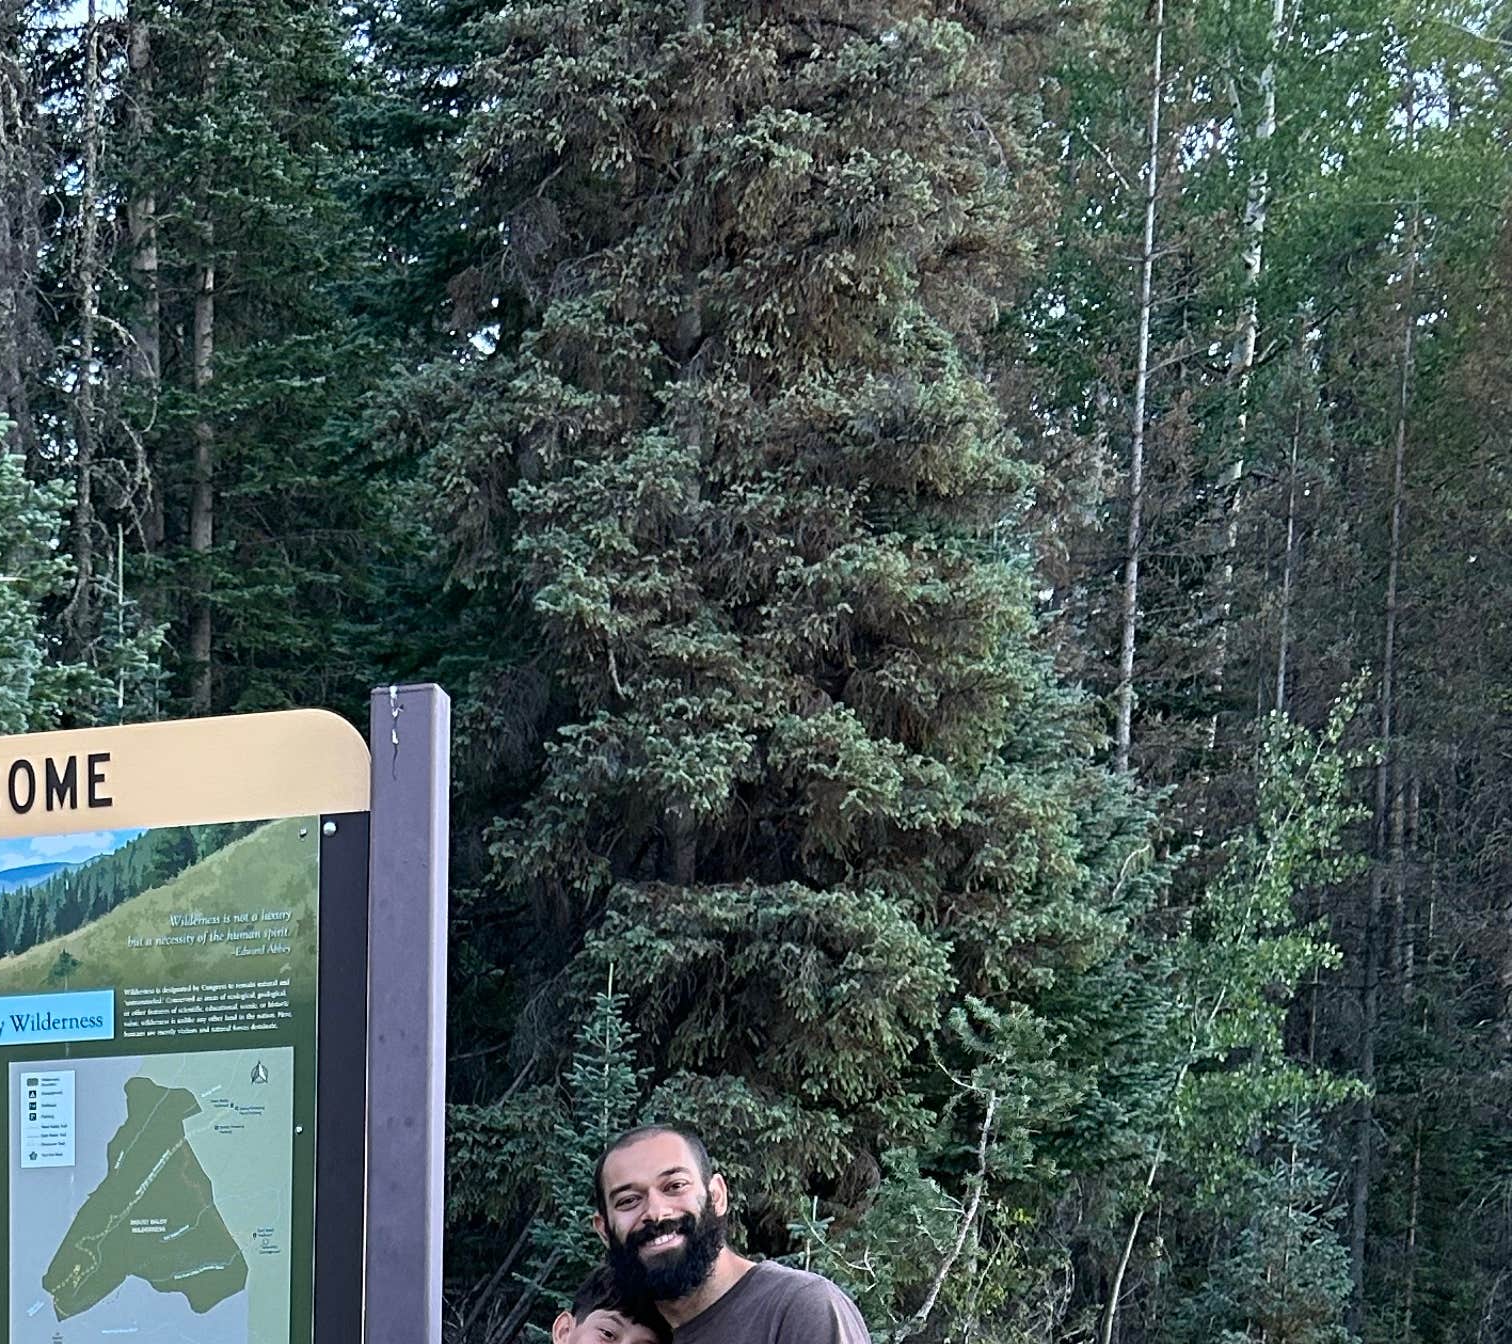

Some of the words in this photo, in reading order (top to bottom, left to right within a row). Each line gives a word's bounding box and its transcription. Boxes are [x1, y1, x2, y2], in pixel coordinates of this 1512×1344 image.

[170, 912, 220, 927] Wilderness
[223, 913, 230, 924] is
[233, 913, 248, 923] not
[251, 914, 257, 922] a
[261, 909, 291, 922] luxury
[127, 935, 143, 948] but
[155, 933, 195, 946] necessity
[197, 931, 208, 945] of
[209, 930, 225, 942] the
[226, 928, 260, 941] human
[8, 1011, 103, 1034] Wilderness
